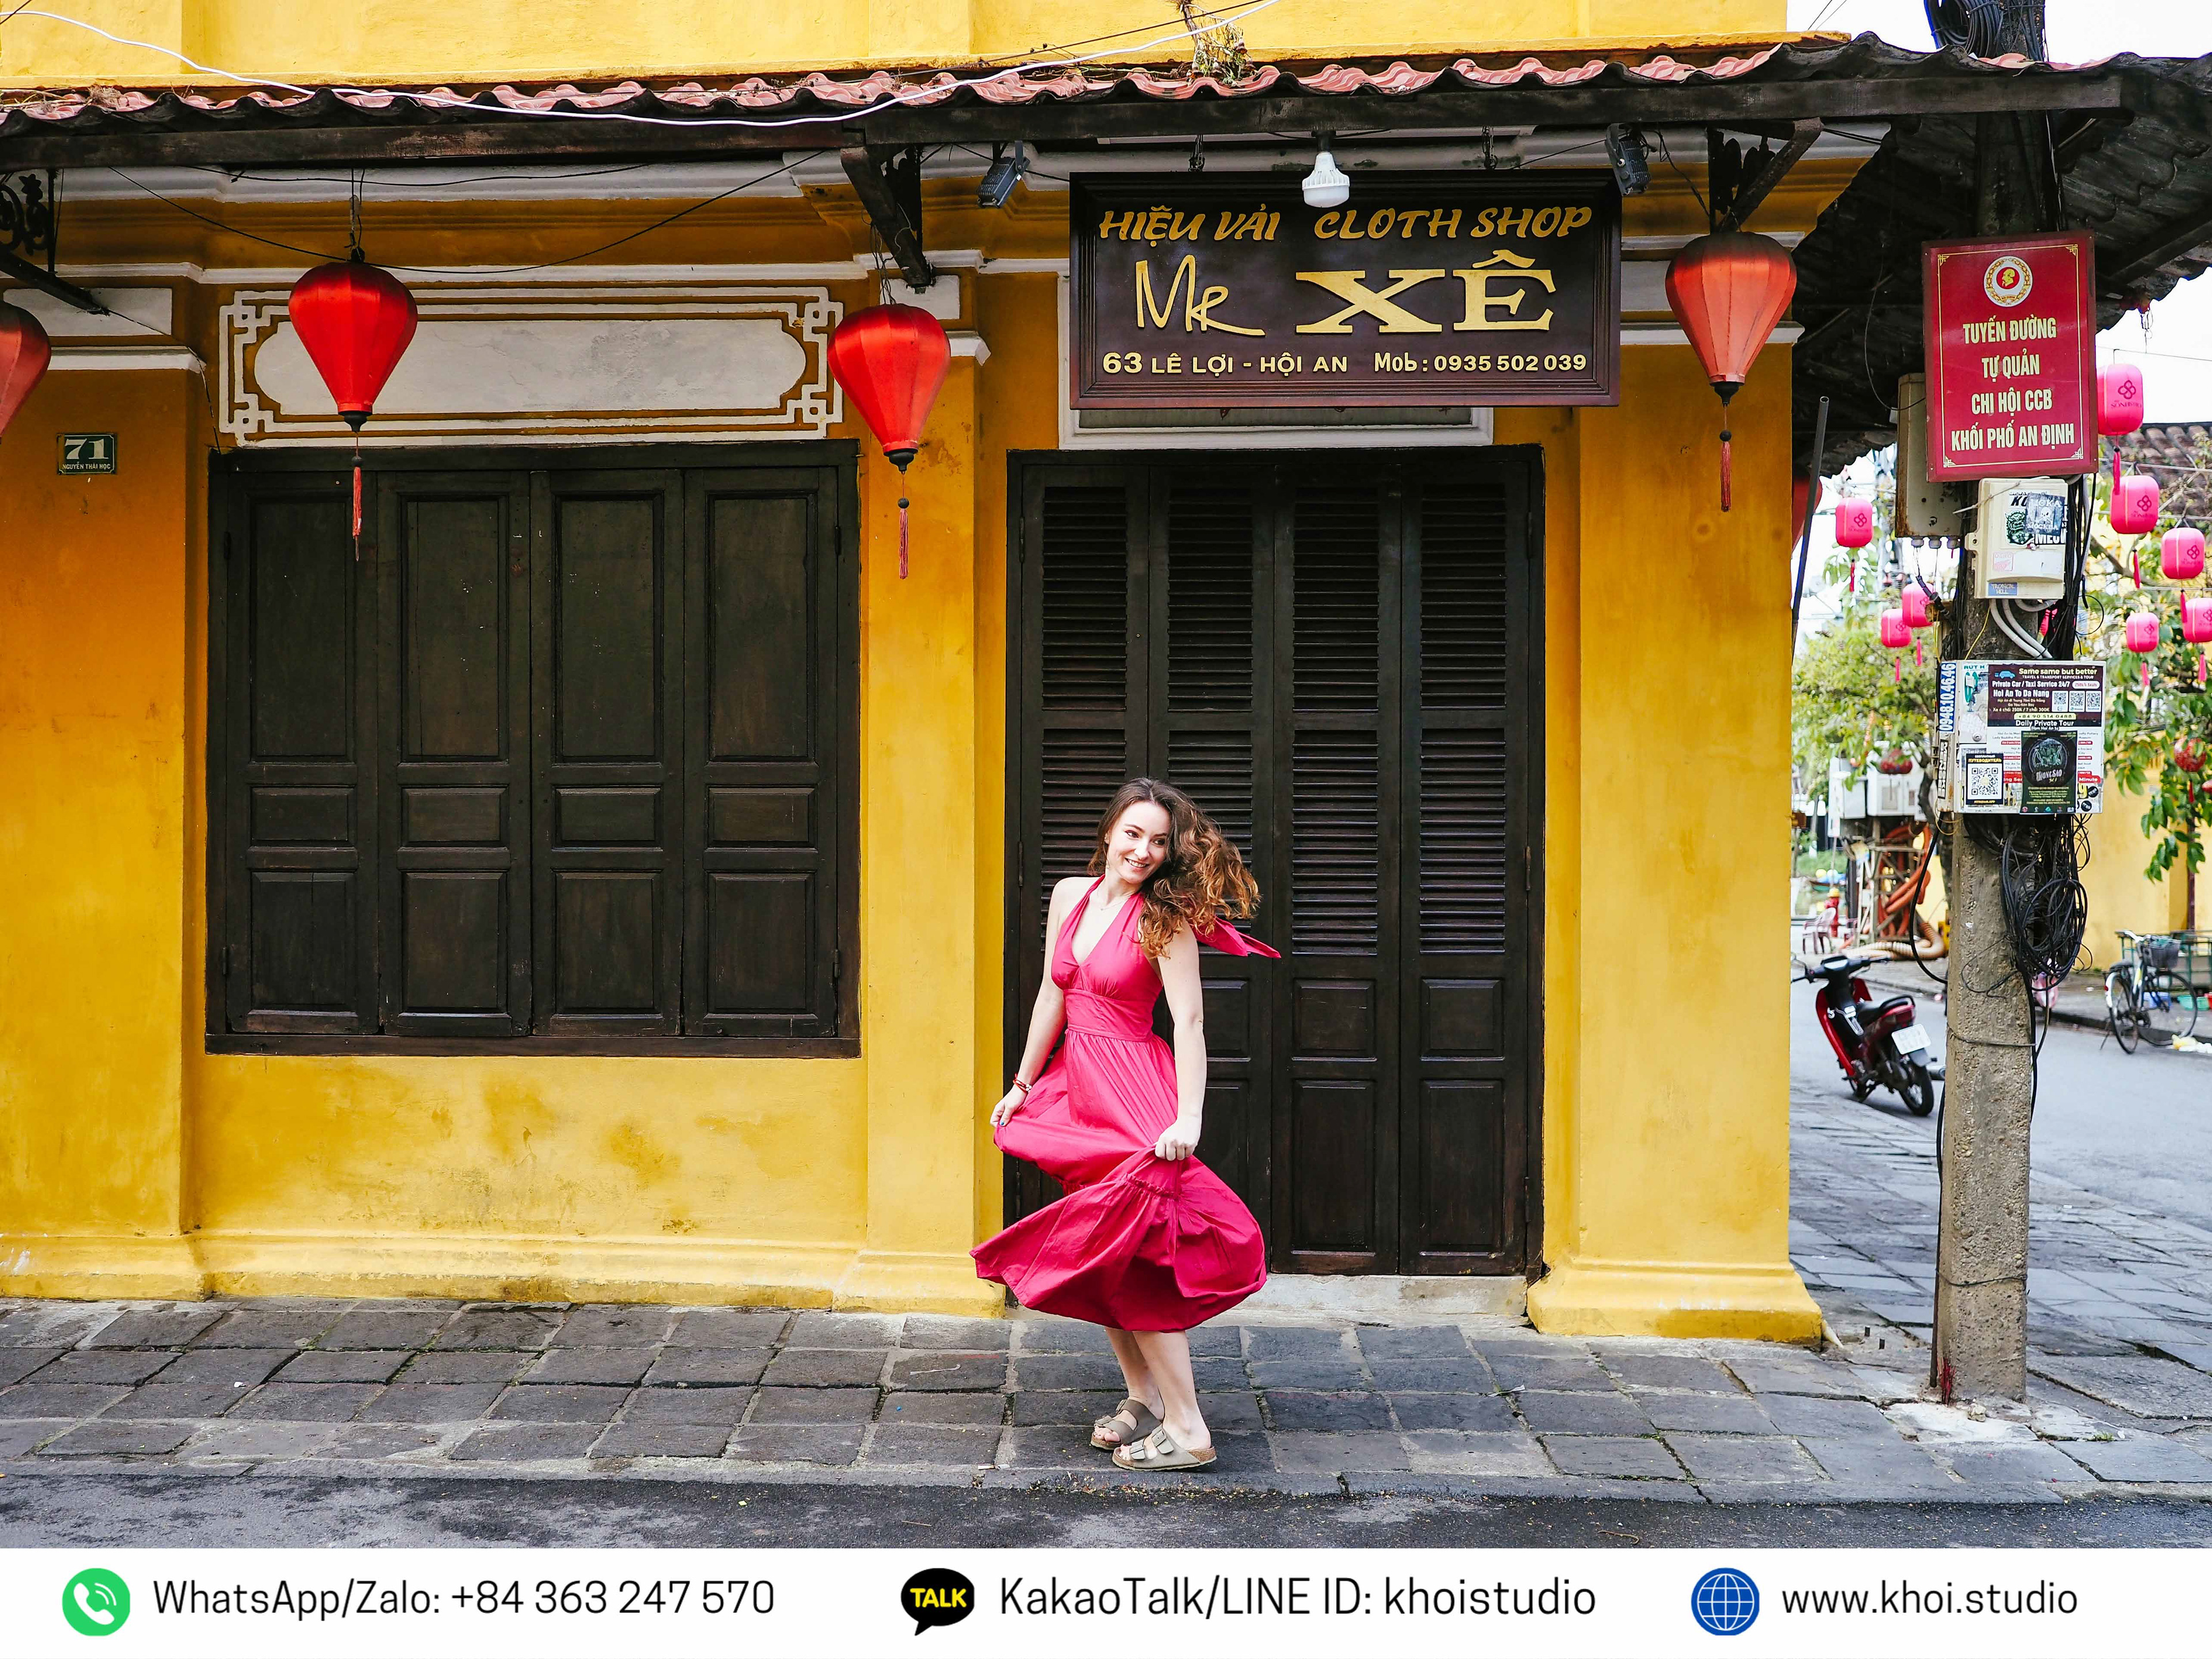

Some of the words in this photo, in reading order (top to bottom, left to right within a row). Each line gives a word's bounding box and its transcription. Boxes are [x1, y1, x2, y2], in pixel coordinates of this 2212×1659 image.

[1100, 205, 1205, 246] HIỆU
[1214, 203, 1280, 241] VẢI
[1315, 208, 1462, 239] CLOTH
[1471, 207, 1592, 238] SHOP
[1296, 249, 1556, 334] XÊ
[1963, 315, 2006, 344] TUYẾN
[2010, 313, 2057, 341] ĐƯỜNG
[1103, 351, 1142, 373] 63
[1152, 352, 1182, 373] LÊ
[1194, 354, 1233, 377] LỢI
[1260, 352, 1301, 377] HỘI
[1313, 356, 1347, 372] AN
[1434, 355, 1491, 372] 0935
[1498, 355, 1539, 371] 502
[1544, 354, 1586, 370] 039
[1982, 355, 2001, 382] TỰ
[2002, 347, 2040, 377] QUẢN
[1971, 393, 1994, 415] CHI
[1998, 387, 2021, 416] HỘI
[2025, 388, 2052, 411] CCB
[65, 438, 109, 460] 71
[1951, 422, 1984, 452] KHỐI
[1987, 419, 2015, 449] PHỐ
[2018, 427, 2039, 447] AN
[2041, 422, 2074, 450] ĐỊNH
[1939, 663, 1956, 731] 0948.10.46.46
[1993, 690, 2004, 698] Hoi
[2005, 690, 2014, 698] An
[2014, 690, 2022, 698] To
[2023, 690, 2032, 698] Da
[2032, 690, 2050, 698] Nang
